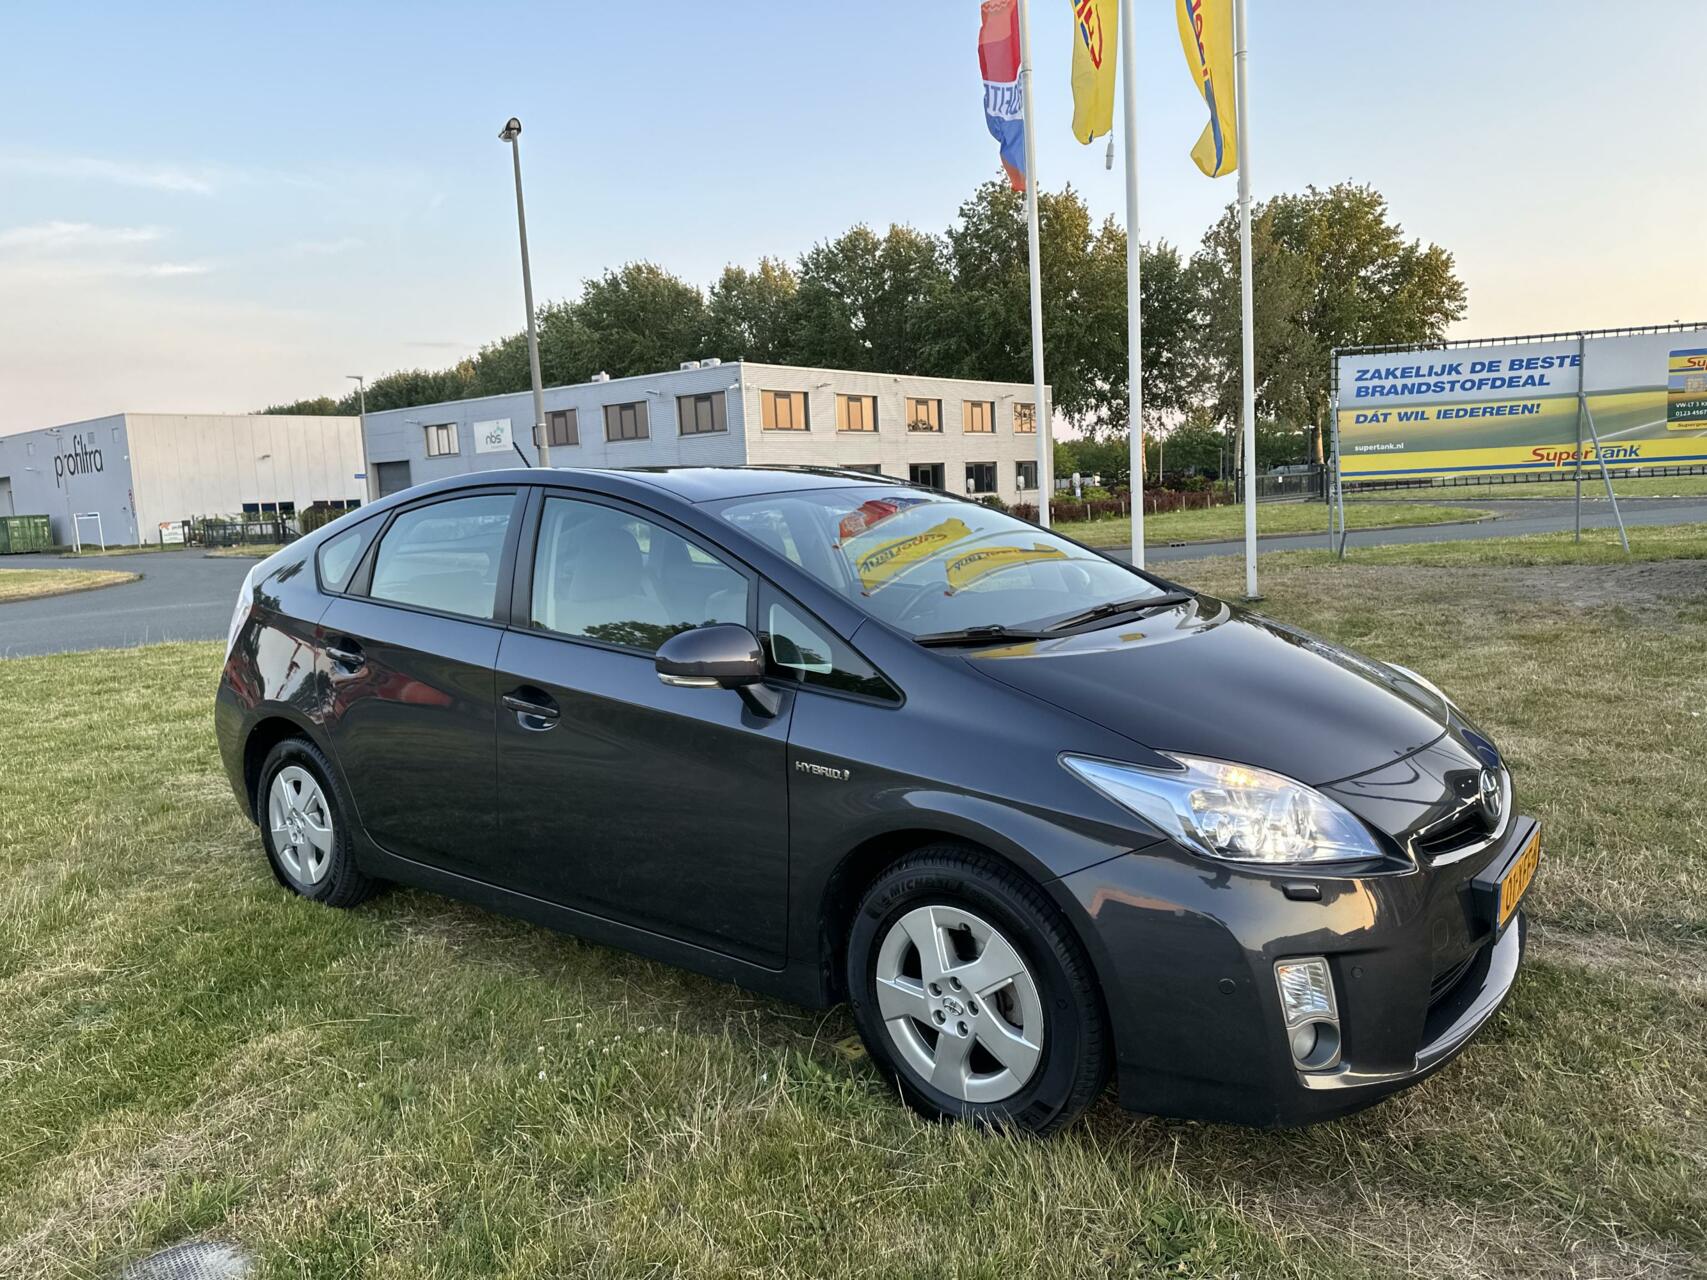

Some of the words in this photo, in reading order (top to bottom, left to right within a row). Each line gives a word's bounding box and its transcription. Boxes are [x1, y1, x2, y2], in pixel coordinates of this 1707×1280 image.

[1354, 363, 1463, 382] ZAKELIJK
[1469, 360, 1502, 374] DE
[1355, 374, 1550, 398] BRANDSTOFDEAL
[1354, 410, 1392, 424] DÁT
[1397, 410, 1430, 422] WIL
[1436, 403, 1541, 420] IEDEREEN!
[485, 432, 502, 445] nbs
[1354, 442, 1404, 452] supertank.nl
[795, 760, 841, 779] HYBRID
